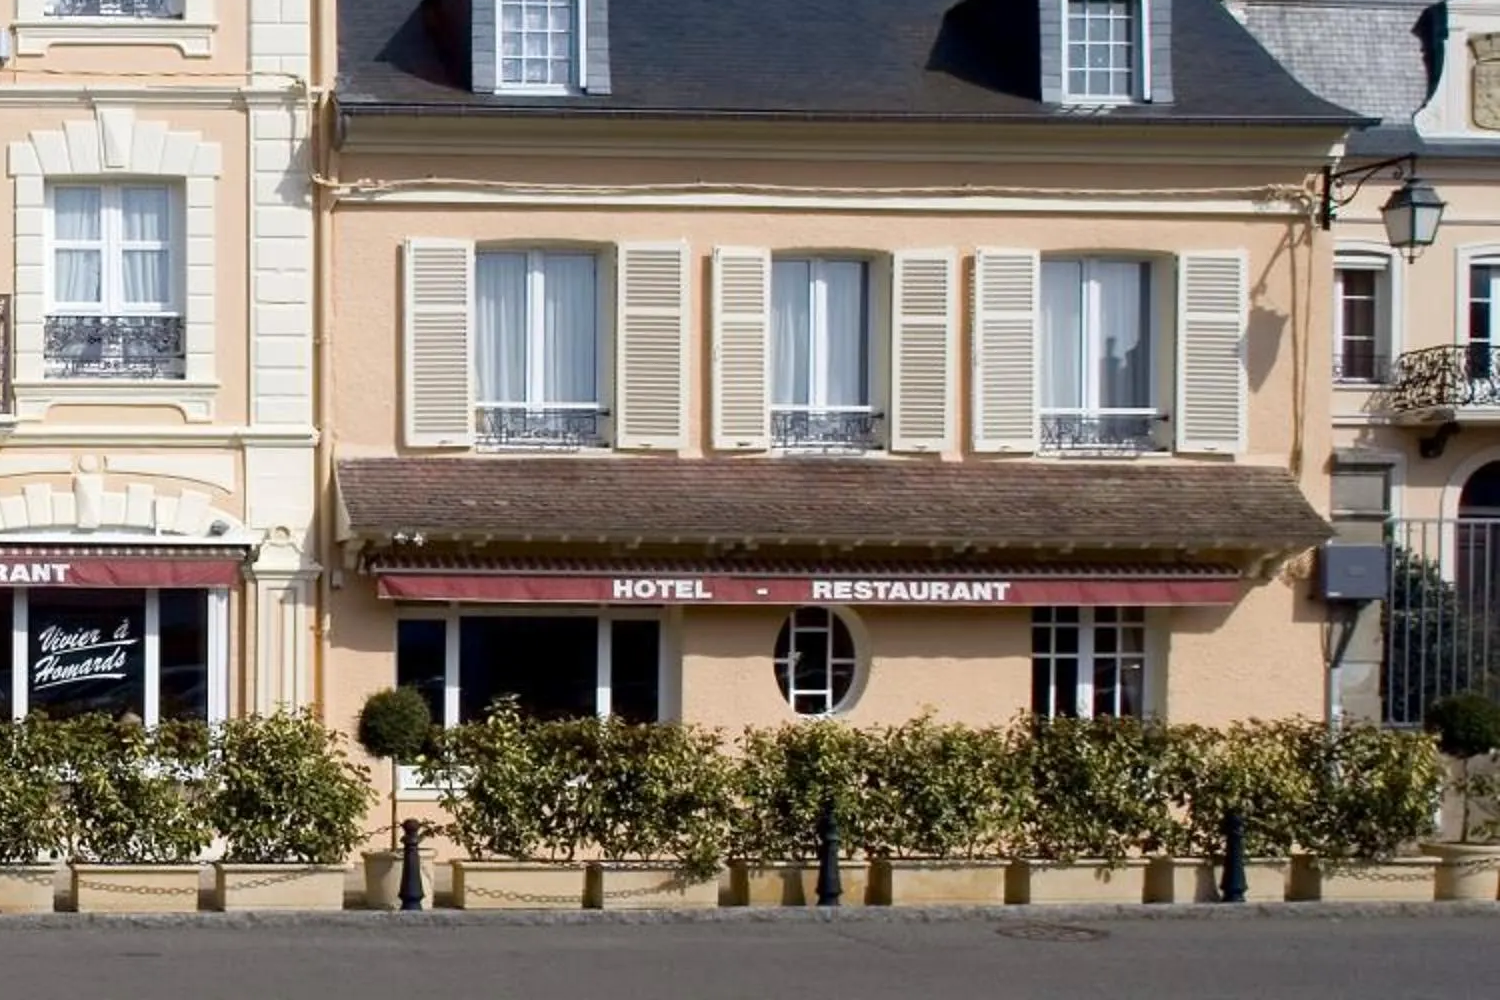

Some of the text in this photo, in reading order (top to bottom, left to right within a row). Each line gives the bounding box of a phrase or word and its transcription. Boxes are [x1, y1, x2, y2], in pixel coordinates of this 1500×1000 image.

[612, 579, 713, 599] HOTEL
[812, 581, 1011, 601] RESTAURANT
[38, 625, 100, 652] Vivier
[34, 646, 127, 683] Homards
